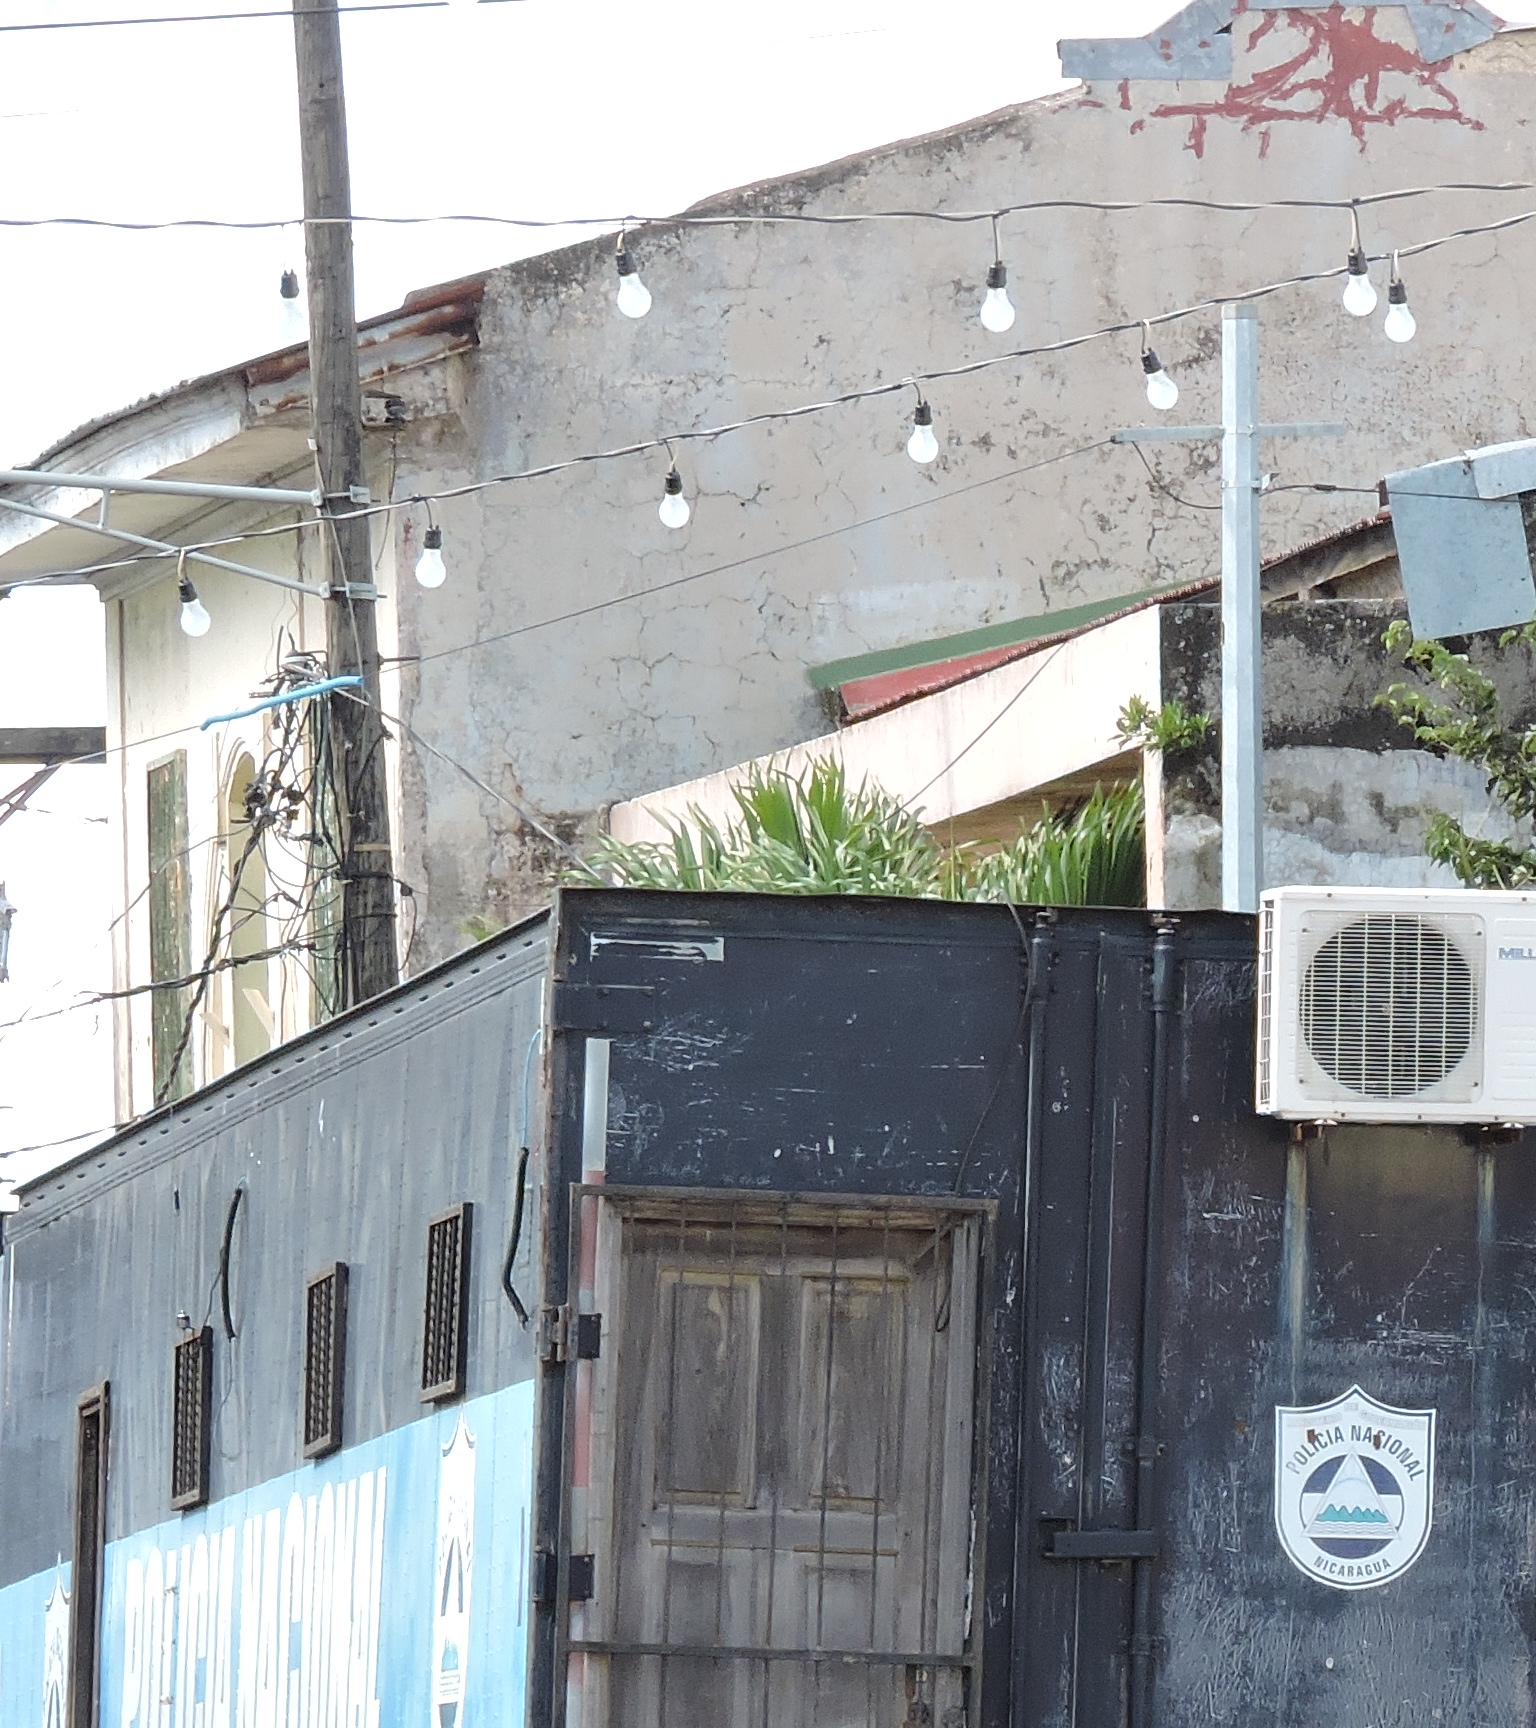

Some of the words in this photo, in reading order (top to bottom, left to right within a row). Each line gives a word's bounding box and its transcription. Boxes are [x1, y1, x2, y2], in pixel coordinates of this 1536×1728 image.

[1286, 1425, 1345, 1475] POLICIA
[1351, 1425, 1425, 1482] NACIONAL
[1313, 1557, 1391, 1578] NICARAGUA
